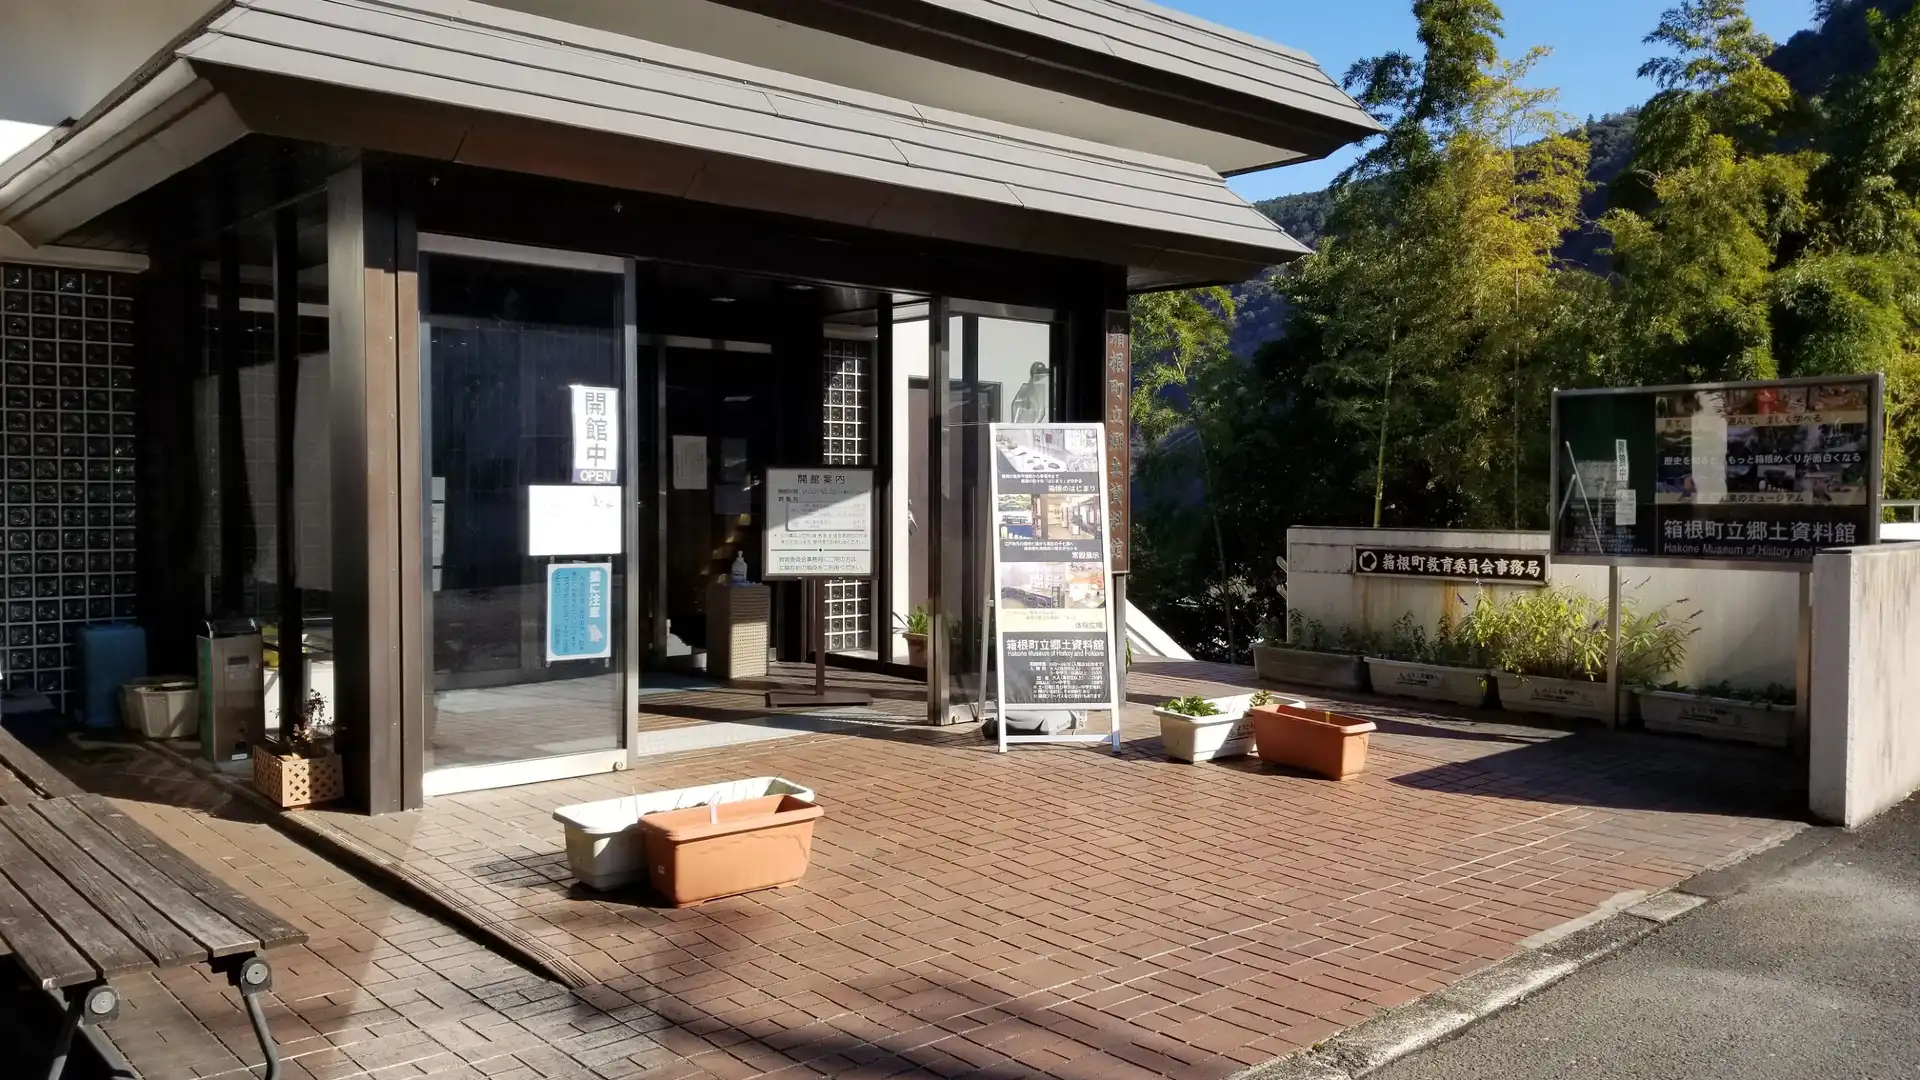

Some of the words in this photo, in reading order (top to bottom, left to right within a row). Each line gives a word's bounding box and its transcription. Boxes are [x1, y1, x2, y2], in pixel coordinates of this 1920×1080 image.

[585, 391, 608, 467] 開館中
[579, 470, 611, 482] OPEN
[797, 474, 845, 484] 開館案内
[1664, 519, 1857, 543] 箱根町立郷土資料館
[1664, 542, 1700, 553] Hakone
[1703, 543, 1743, 555] Museum
[1747, 545, 1756, 555] of
[1758, 546, 1790, 558] History
[1793, 548, 1813, 557] and
[1382, 553, 1541, 578] 箱根町教育委員会事務局
[1006, 639, 1104, 651] 箱根町立郷土資料館
